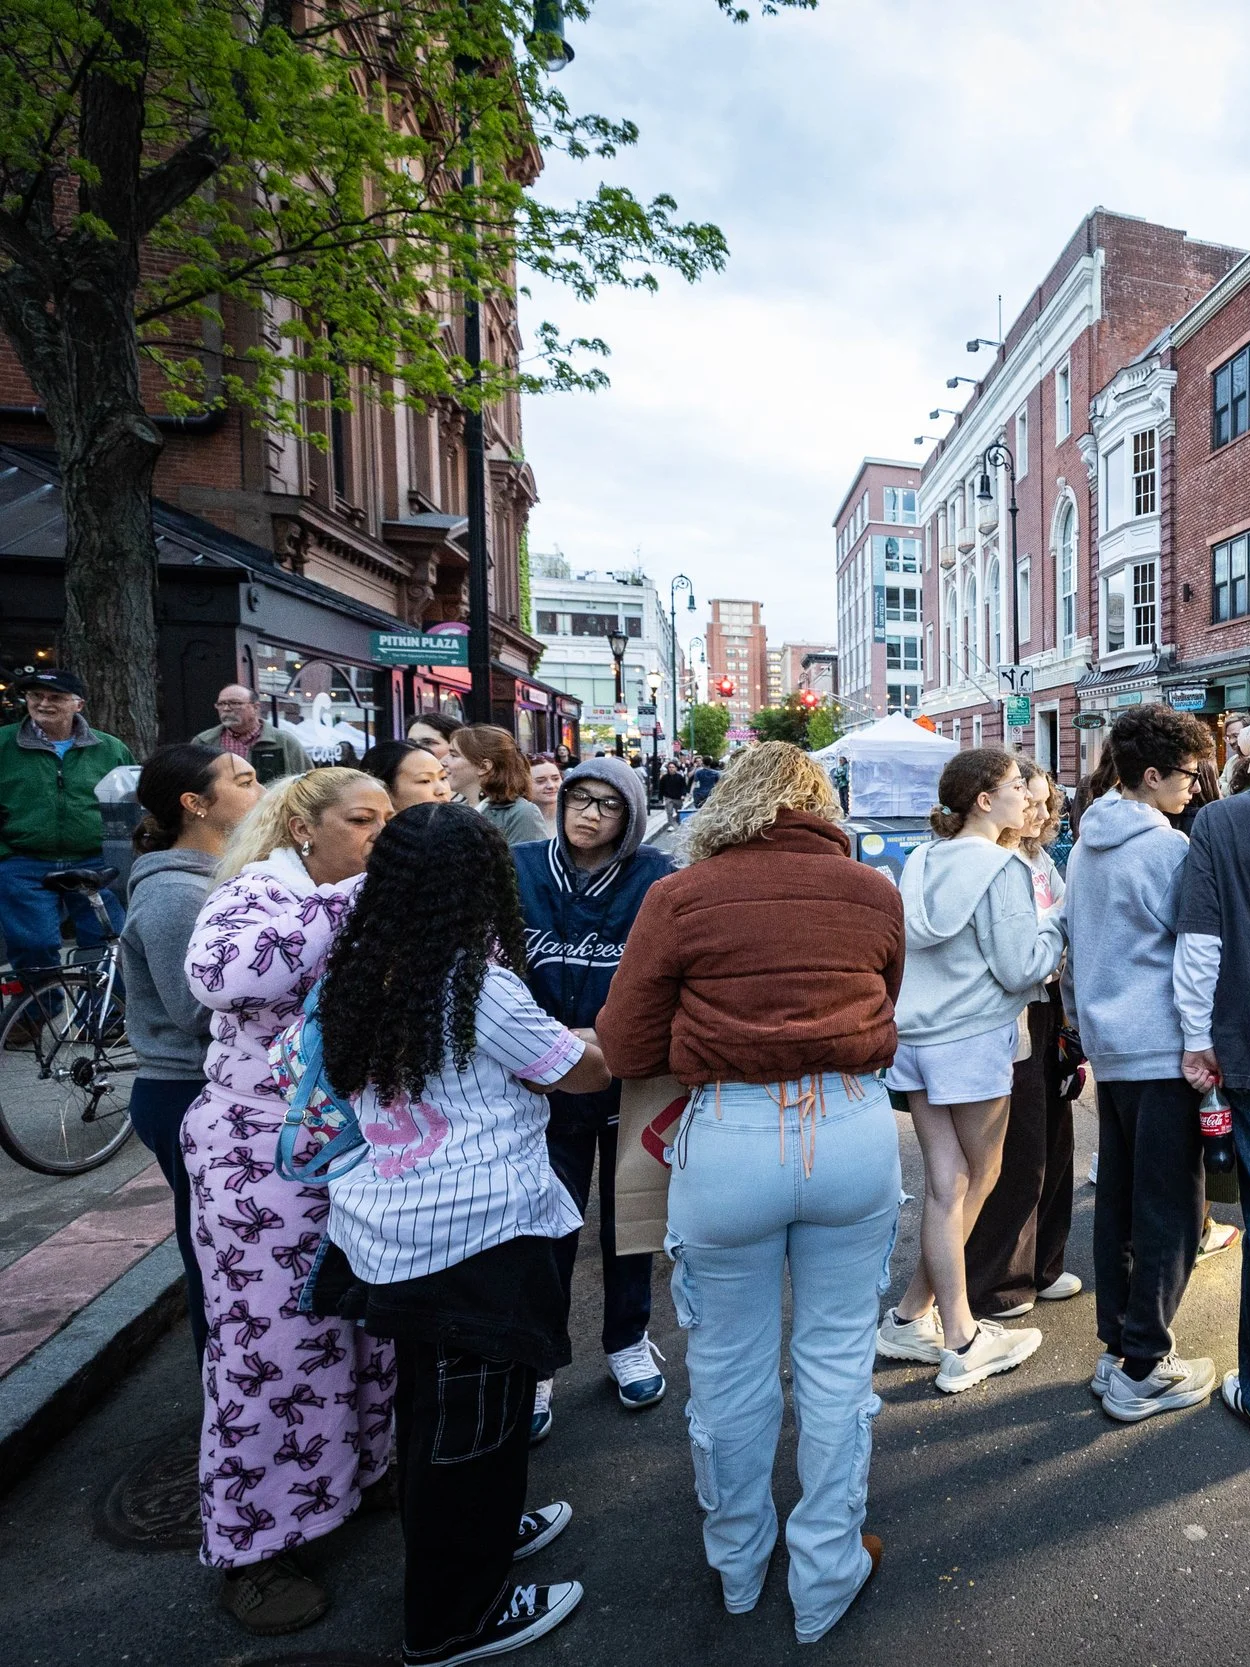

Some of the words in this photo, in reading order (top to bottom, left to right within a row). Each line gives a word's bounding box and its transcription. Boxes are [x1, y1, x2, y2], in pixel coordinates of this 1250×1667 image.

[379, 634, 419, 647] PITKIN
[421, 637, 460, 649] PLAZA
[523, 928, 627, 965] Yankees
